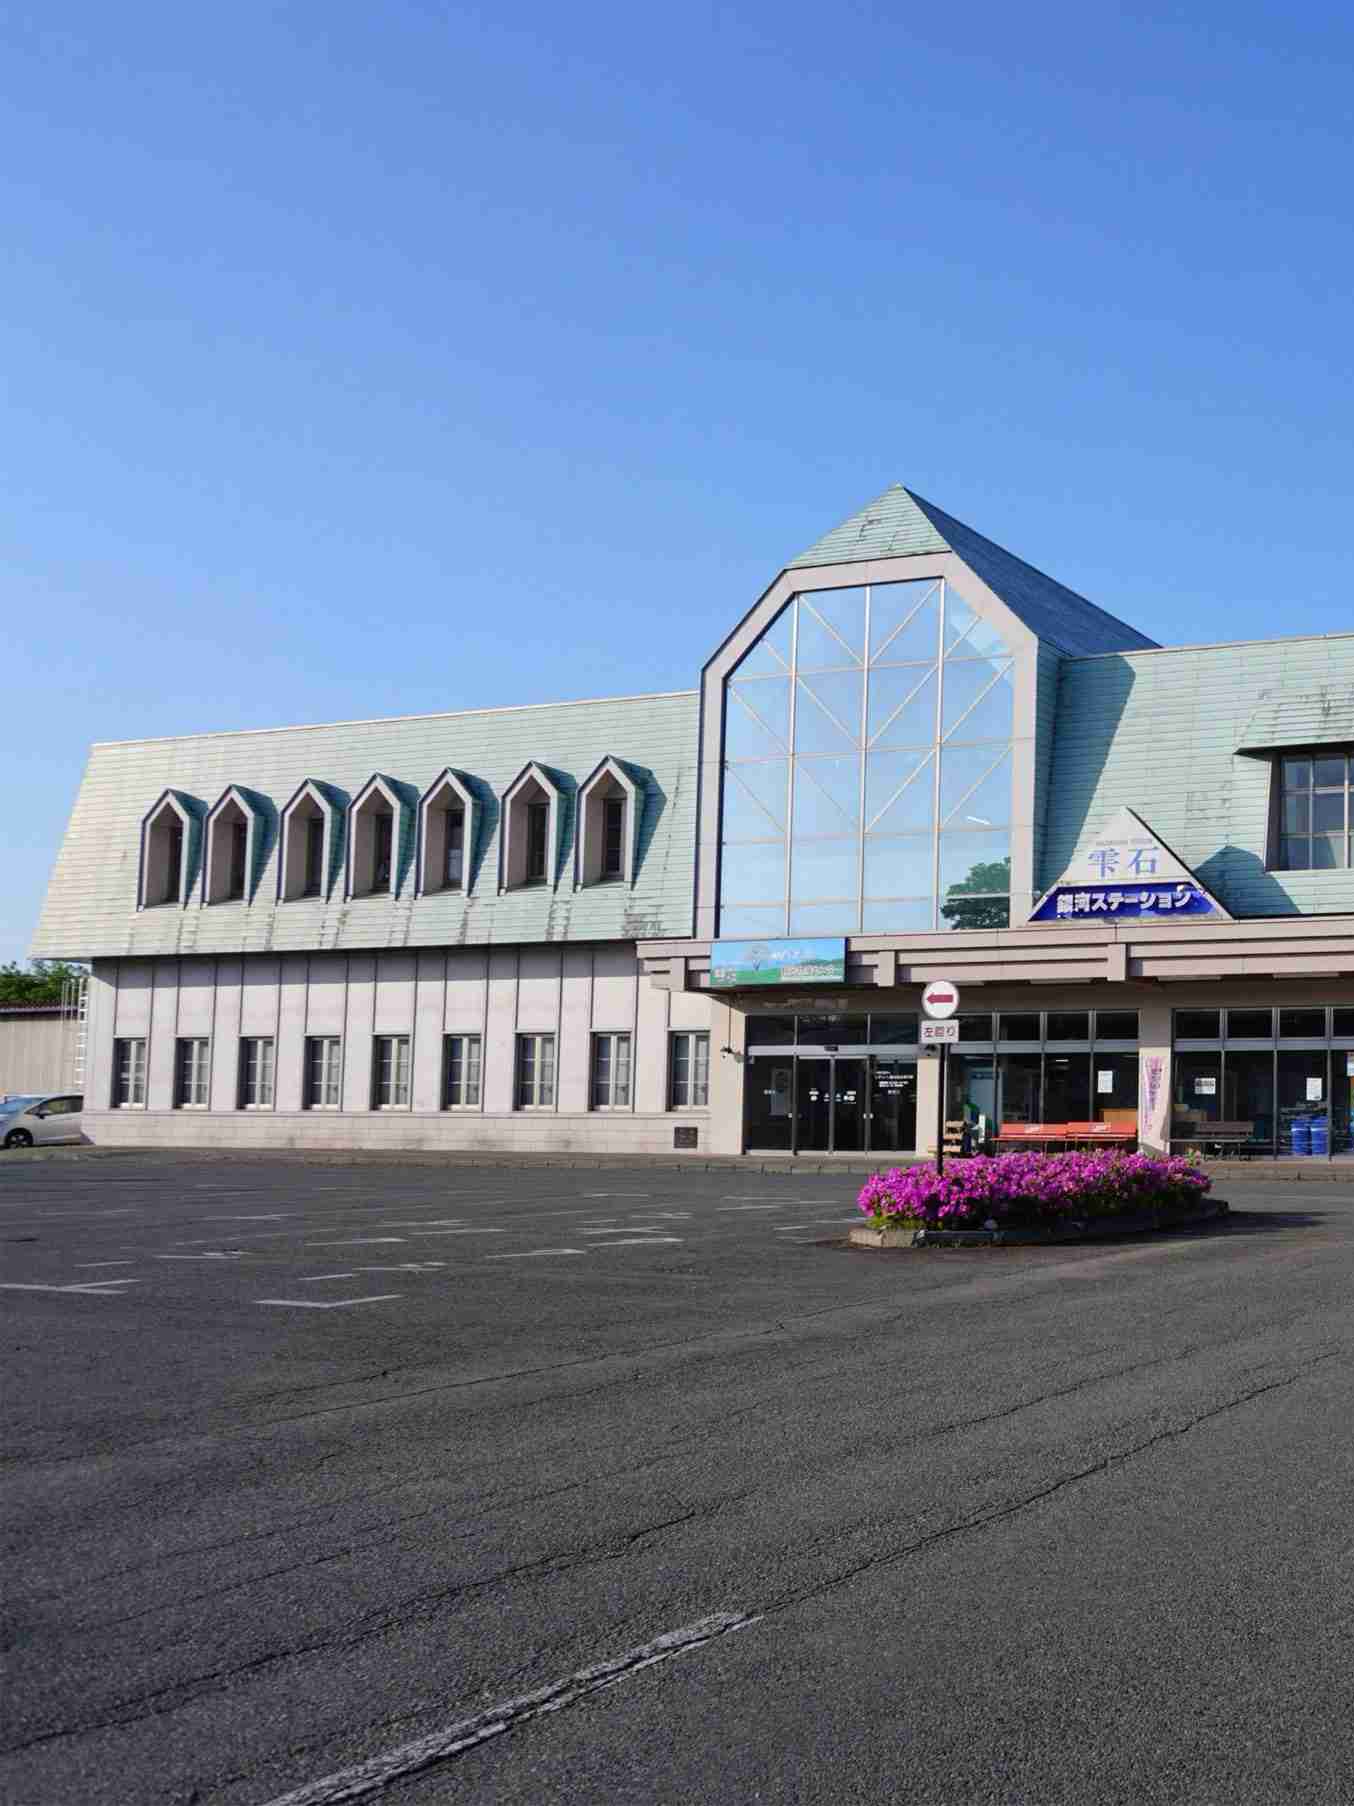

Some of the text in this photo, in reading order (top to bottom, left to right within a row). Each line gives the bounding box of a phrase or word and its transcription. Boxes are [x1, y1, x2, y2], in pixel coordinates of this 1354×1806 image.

[1088, 846, 1160, 879] 雫石
[1056, 887, 1191, 913] 銀河ステーション
[924, 1025, 956, 1038] 左回り
